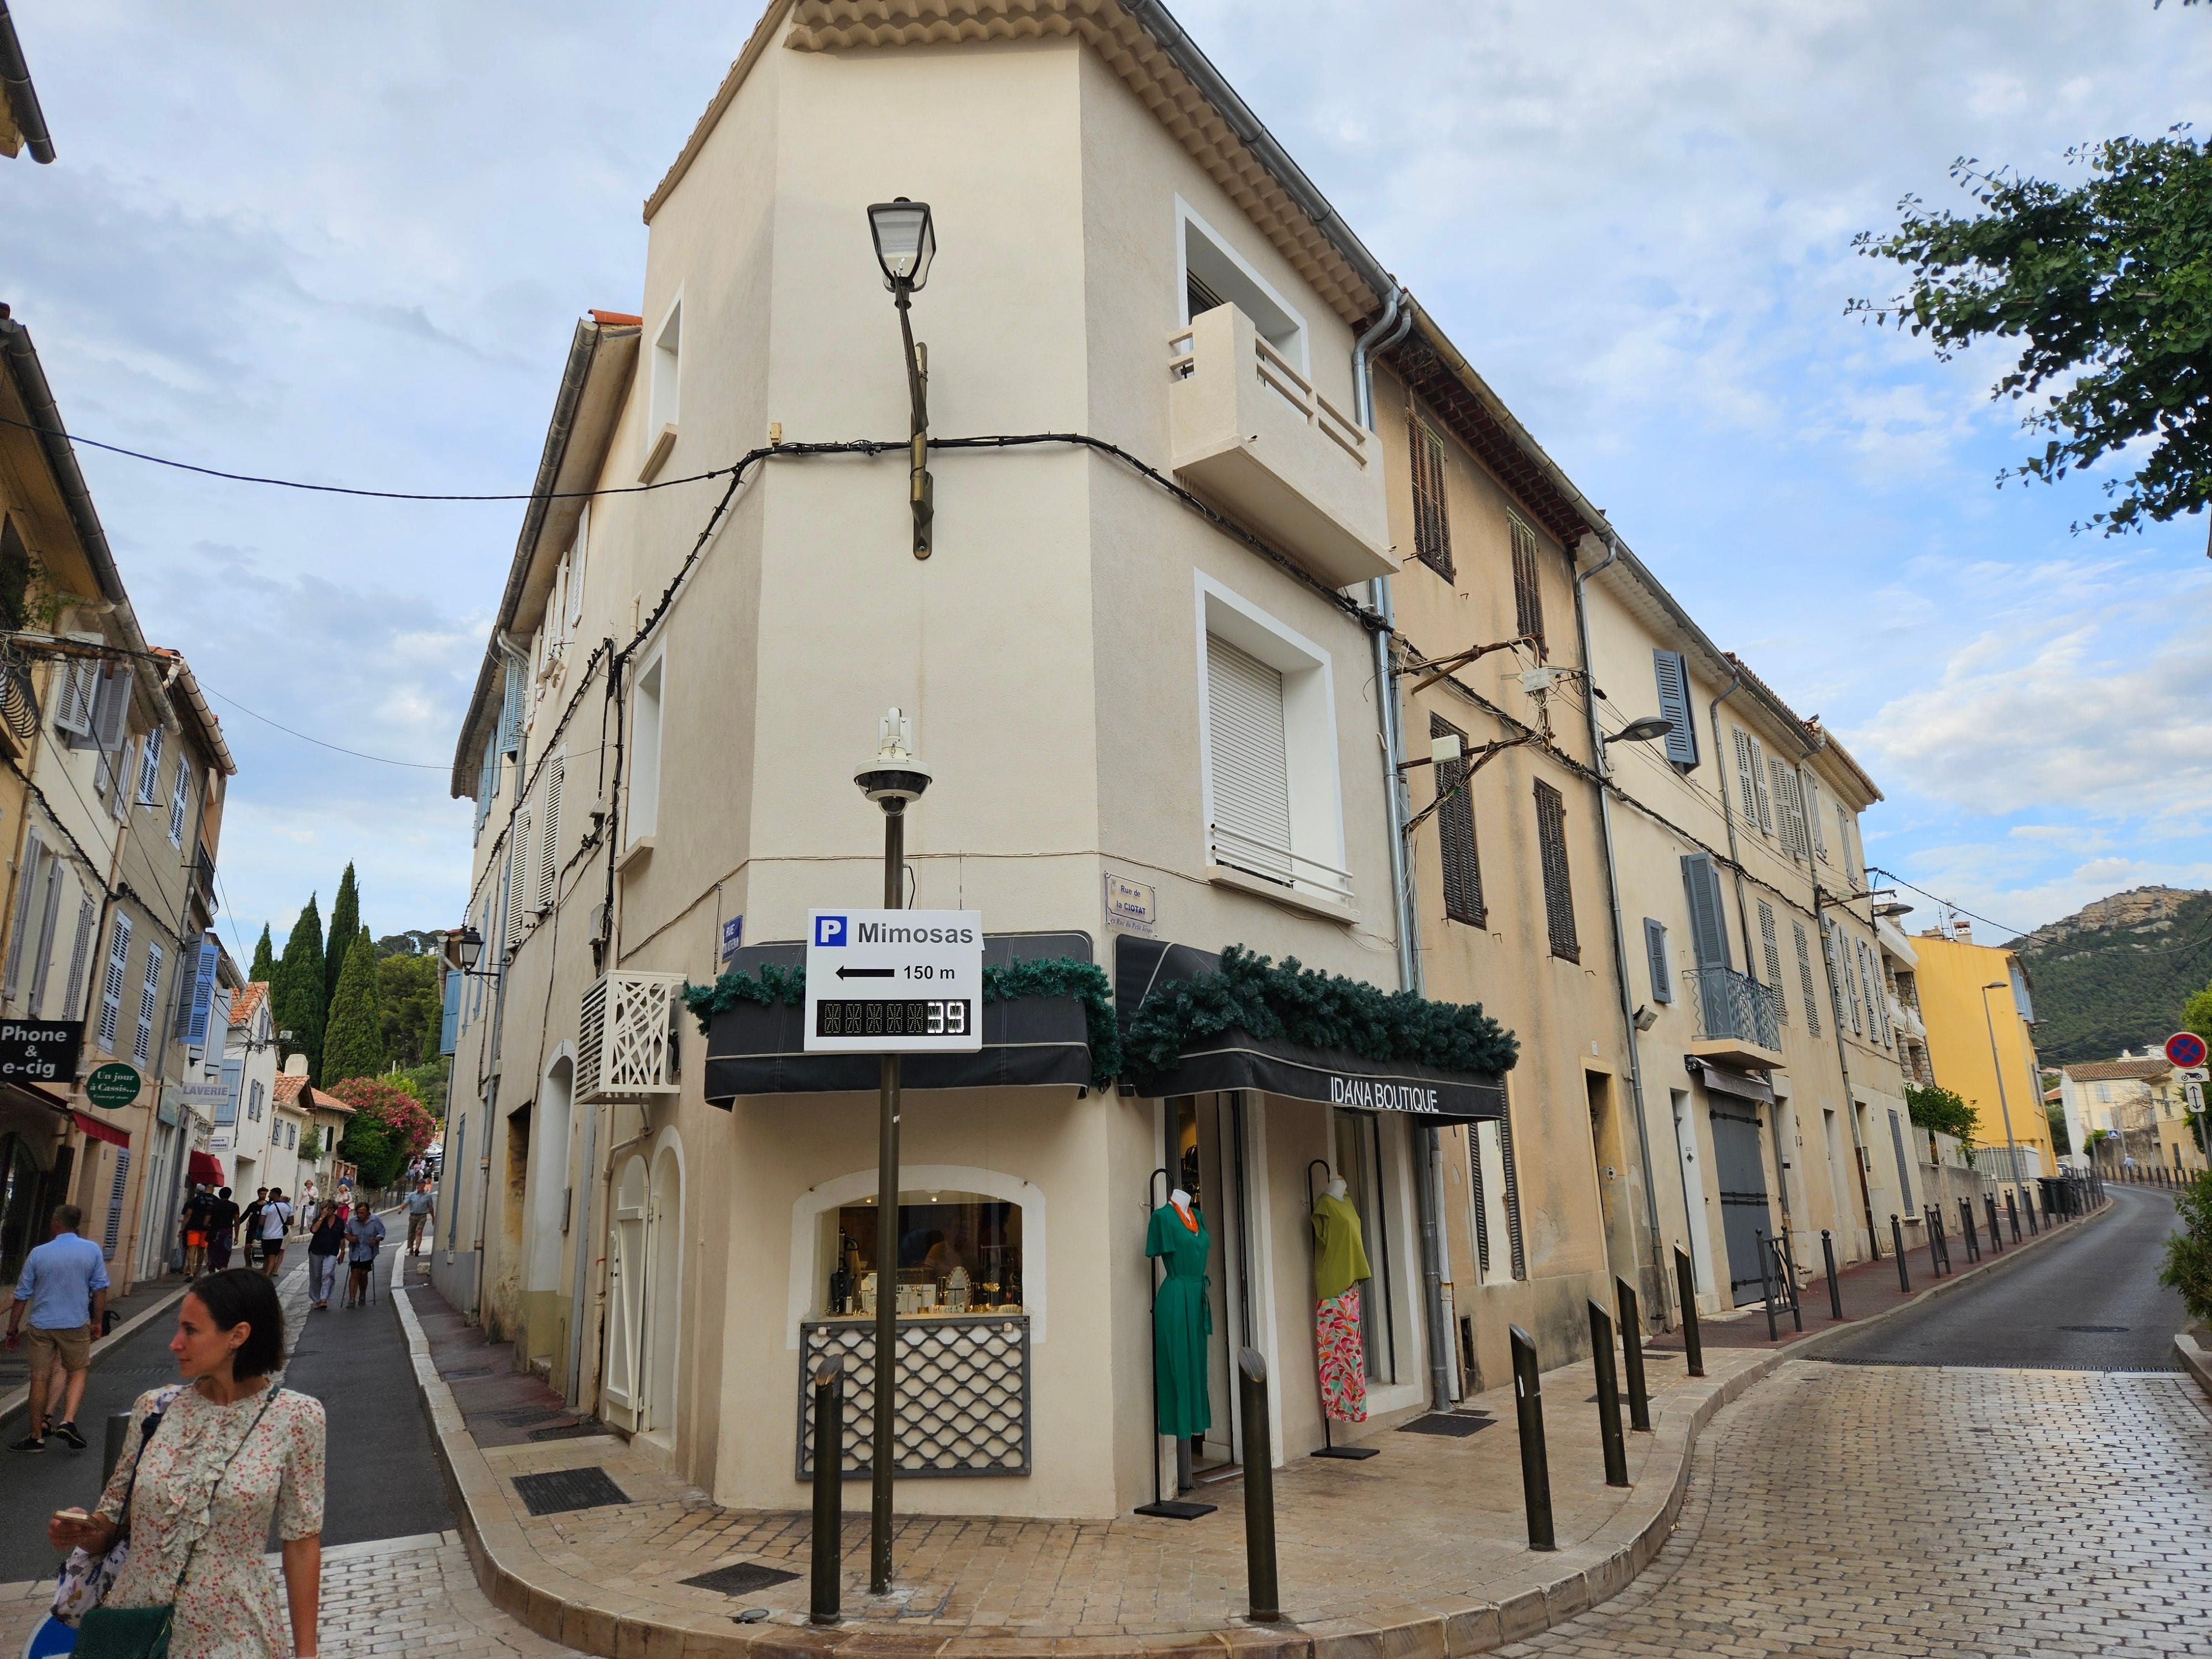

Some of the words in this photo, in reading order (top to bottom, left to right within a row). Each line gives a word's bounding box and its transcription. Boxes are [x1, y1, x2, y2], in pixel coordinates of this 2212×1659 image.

[1121, 885, 1132, 895] Rue
[1117, 900, 1122, 909] la
[1124, 902, 1146, 915] CIOTAT
[821, 920, 842, 943] P
[858, 923, 973, 943] Mimosas
[904, 966, 933, 979] 150
[940, 968, 955, 979] m
[927, 1001, 964, 1034] 39
[1, 1026, 67, 1042] Phone
[25, 1045, 38, 1057] &
[2, 1059, 56, 1078] e-cig
[112, 1073, 134, 1082] jour
[98, 1083, 136, 1093] Cassis...
[182, 1086, 228, 1095] LAVERIE
[1331, 1076, 1374, 1107] IDANA
[1375, 1083, 1439, 1113] BOUTIQUE
